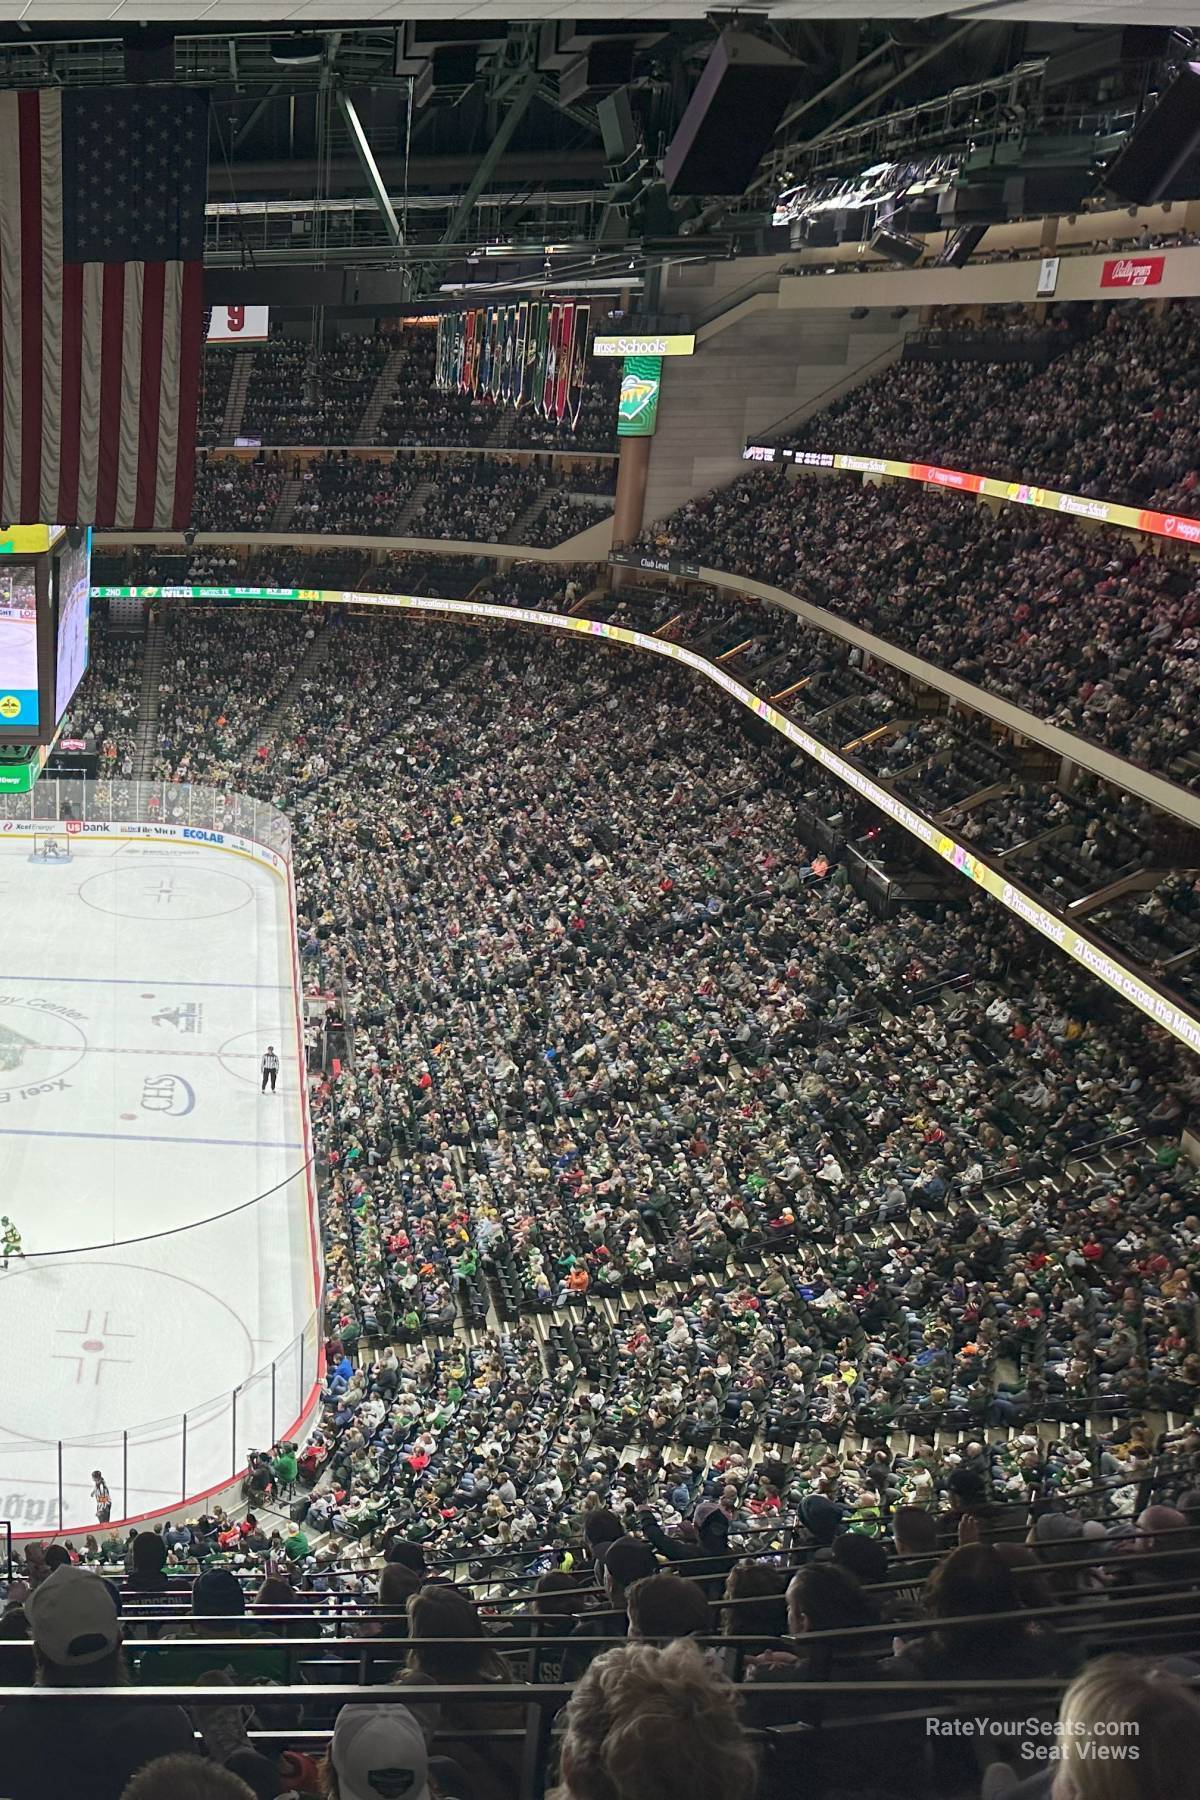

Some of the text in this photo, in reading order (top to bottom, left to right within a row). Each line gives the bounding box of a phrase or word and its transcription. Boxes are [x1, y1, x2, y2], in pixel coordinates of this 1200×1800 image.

[227, 306, 245, 331] 9
[618, 339, 663, 353] Schools
[67, 822, 110, 832] us bank
[183, 829, 224, 844] ECOLAB
[1038, 913, 1066, 944] Schools
[1073, 938, 1083, 956] 21
[1082, 943, 1123, 985] locations
[1122, 974, 1155, 1010] across
[1154, 996, 1174, 1024] the
[26, 997, 90, 1023] Center
[20, 1078, 73, 1101] Xcel
[140, 1077, 175, 1111] CHS
